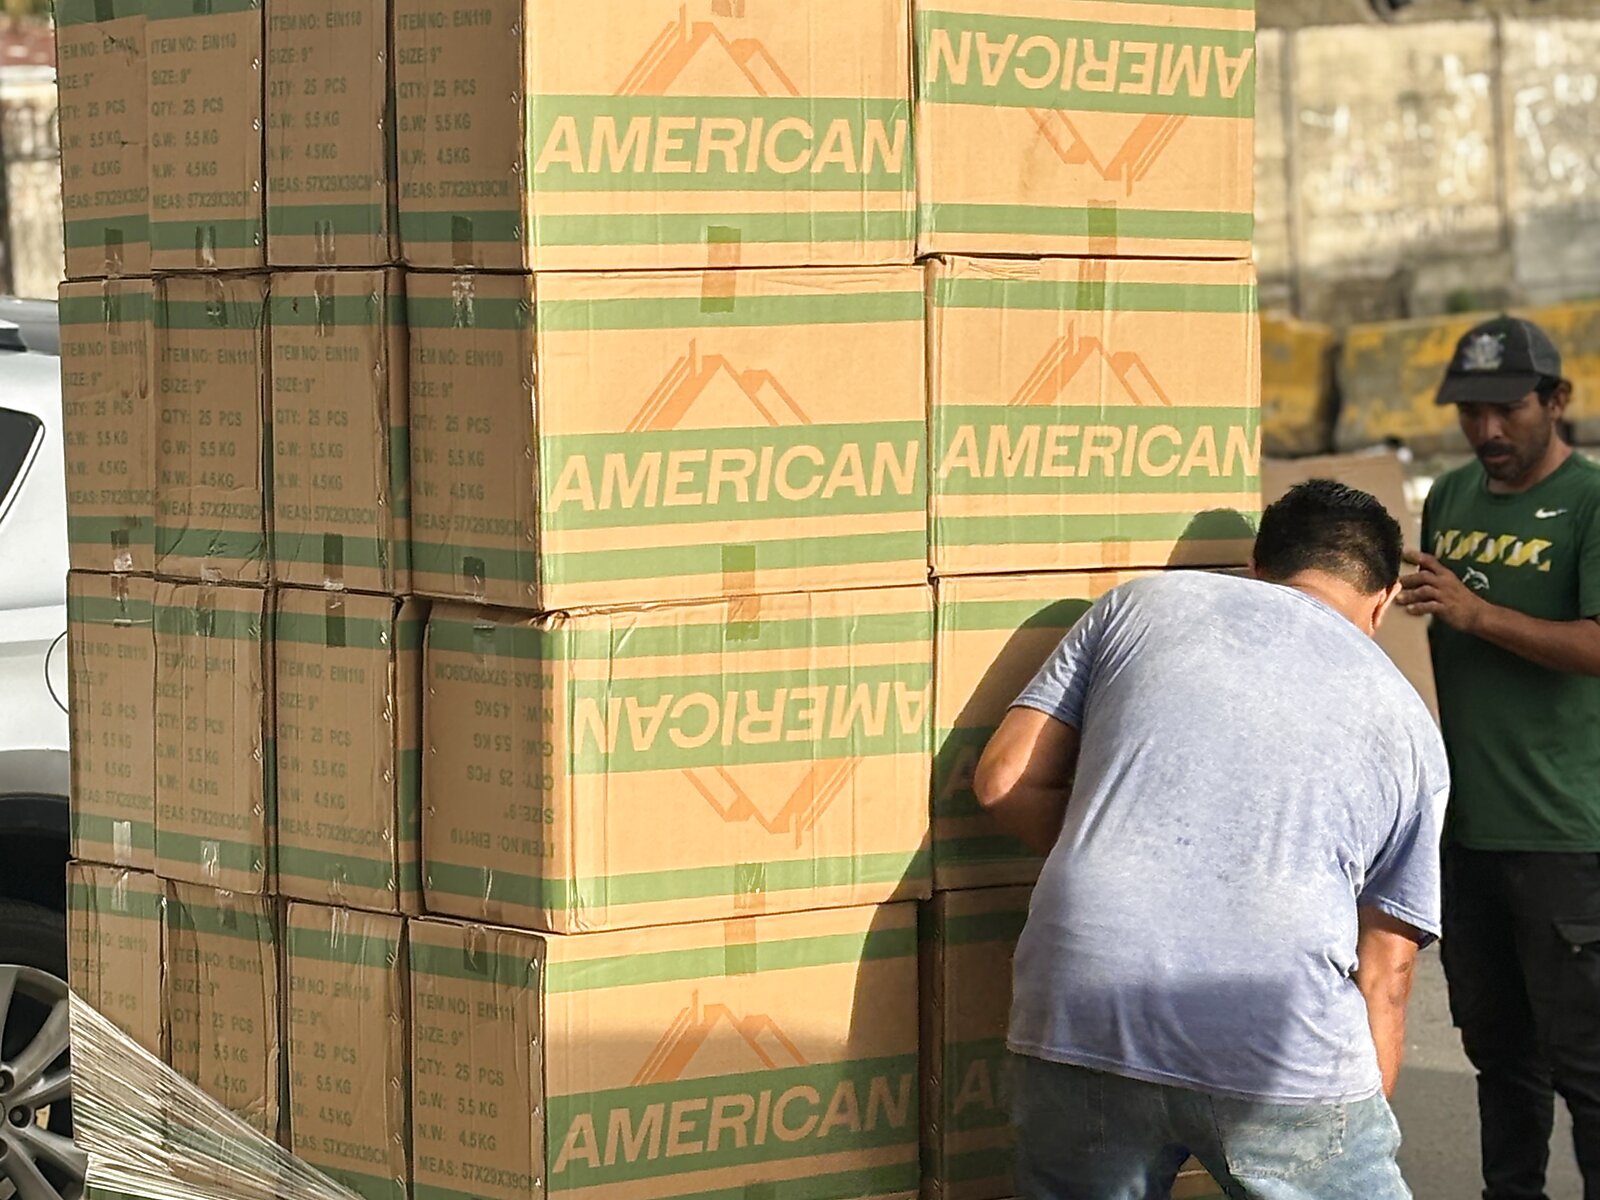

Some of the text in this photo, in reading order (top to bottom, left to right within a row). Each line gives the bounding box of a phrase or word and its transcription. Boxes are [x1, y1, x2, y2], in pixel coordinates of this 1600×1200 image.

[928, 28, 1252, 100] AMERICAN
[303, 78, 316, 96] 25
[323, 77, 346, 94] PCS
[433, 79, 446, 97] 25
[453, 78, 477, 96] PCS
[183, 98, 195, 115] 25
[202, 96, 223, 113] PCS
[535, 115, 903, 176] AMERICAN
[198, 409, 212, 425] 25
[218, 410, 242, 426] PCS
[327, 410, 348, 426] PCS
[466, 416, 490, 433] PCS
[939, 424, 1262, 479] AMERICAN
[548, 441, 918, 512] AMERICAN
[574, 680, 934, 754] AMERICAN
[466, 764, 491, 783] PCS
[499, 768, 513, 786] 25
[333, 1045, 356, 1065] PCS
[455, 1062, 468, 1081] 25
[478, 1066, 504, 1087] PCS
[552, 1073, 914, 1174] AMERICAN
[294, 1133, 318, 1151] EAS:
